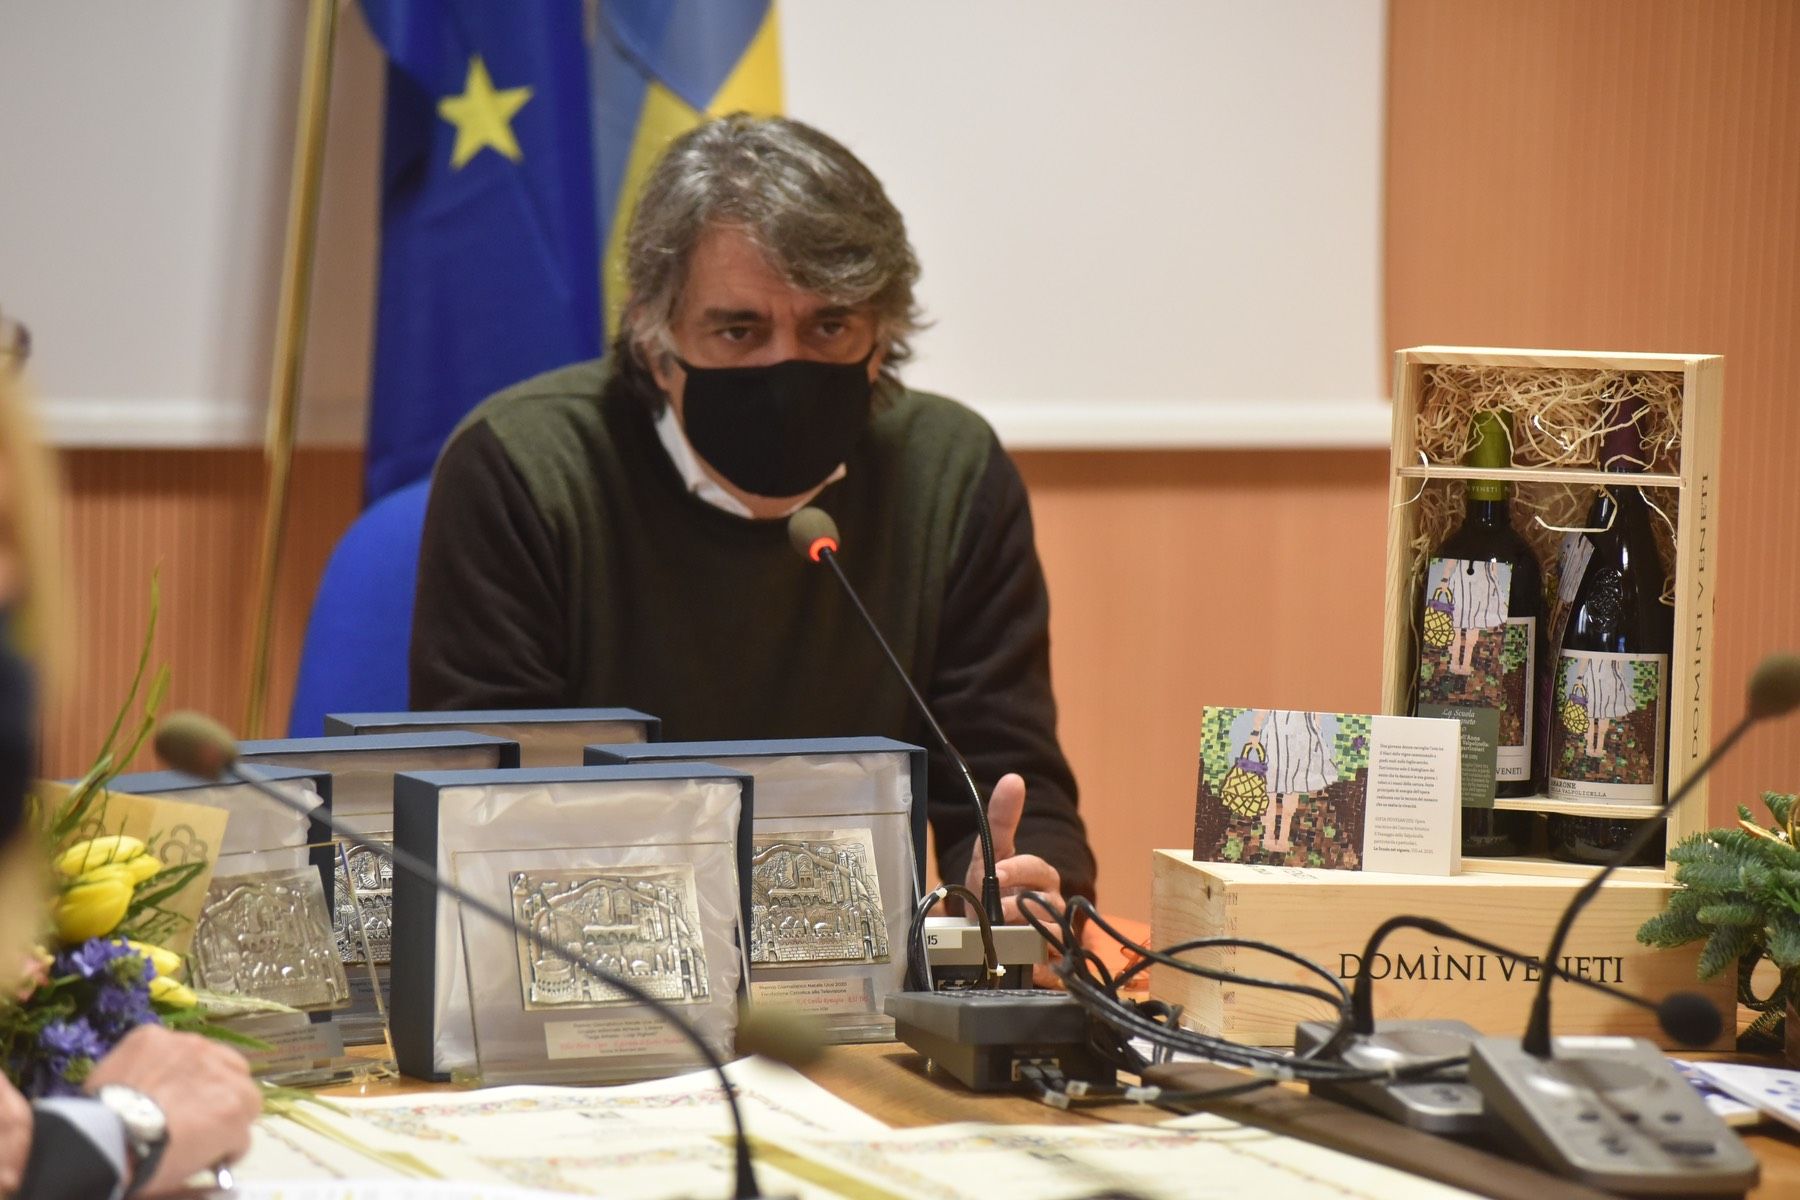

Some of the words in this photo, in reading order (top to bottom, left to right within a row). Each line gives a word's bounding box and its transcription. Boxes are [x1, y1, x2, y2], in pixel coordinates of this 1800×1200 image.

[1697, 475, 1709, 600] VENETI
[1453, 708, 1475, 718] Scuola
[1495, 767, 1522, 776] VENETI
[1339, 946, 1487, 981] DOMÌNI
[1496, 956, 1625, 983] VENETI
